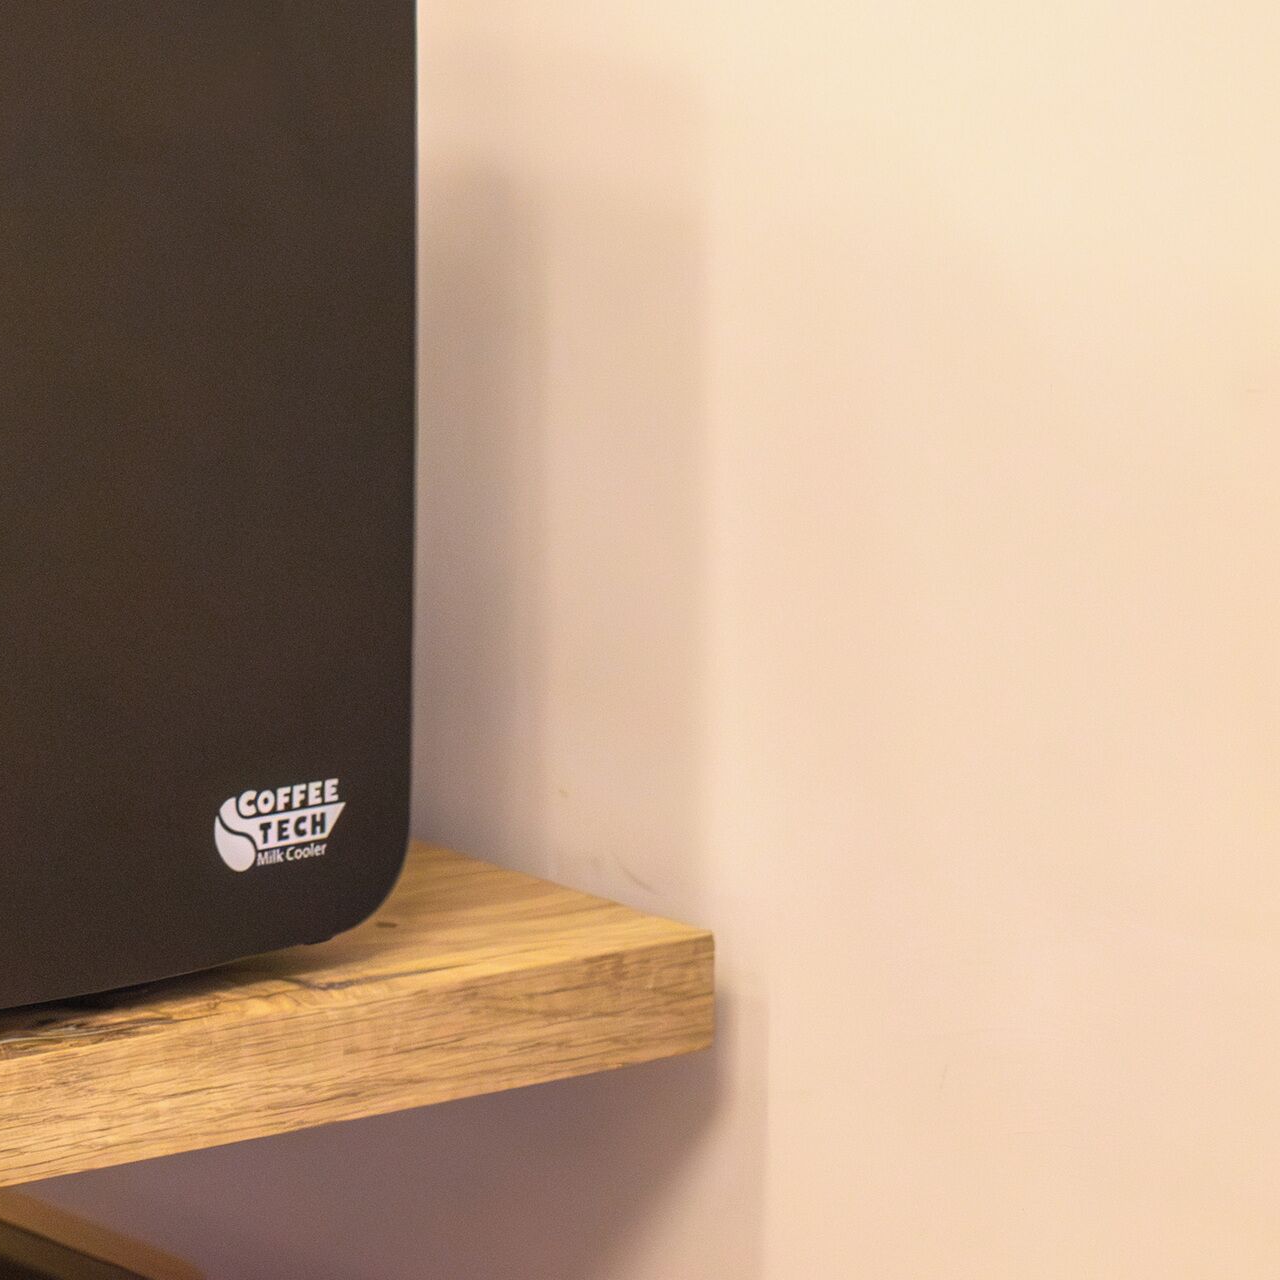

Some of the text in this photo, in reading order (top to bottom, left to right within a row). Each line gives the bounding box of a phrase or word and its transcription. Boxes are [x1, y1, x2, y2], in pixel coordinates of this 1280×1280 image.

[238, 778, 339, 817] COFFEE
[259, 812, 326, 844] TECH
[256, 842, 328, 867] Milk Cooler
